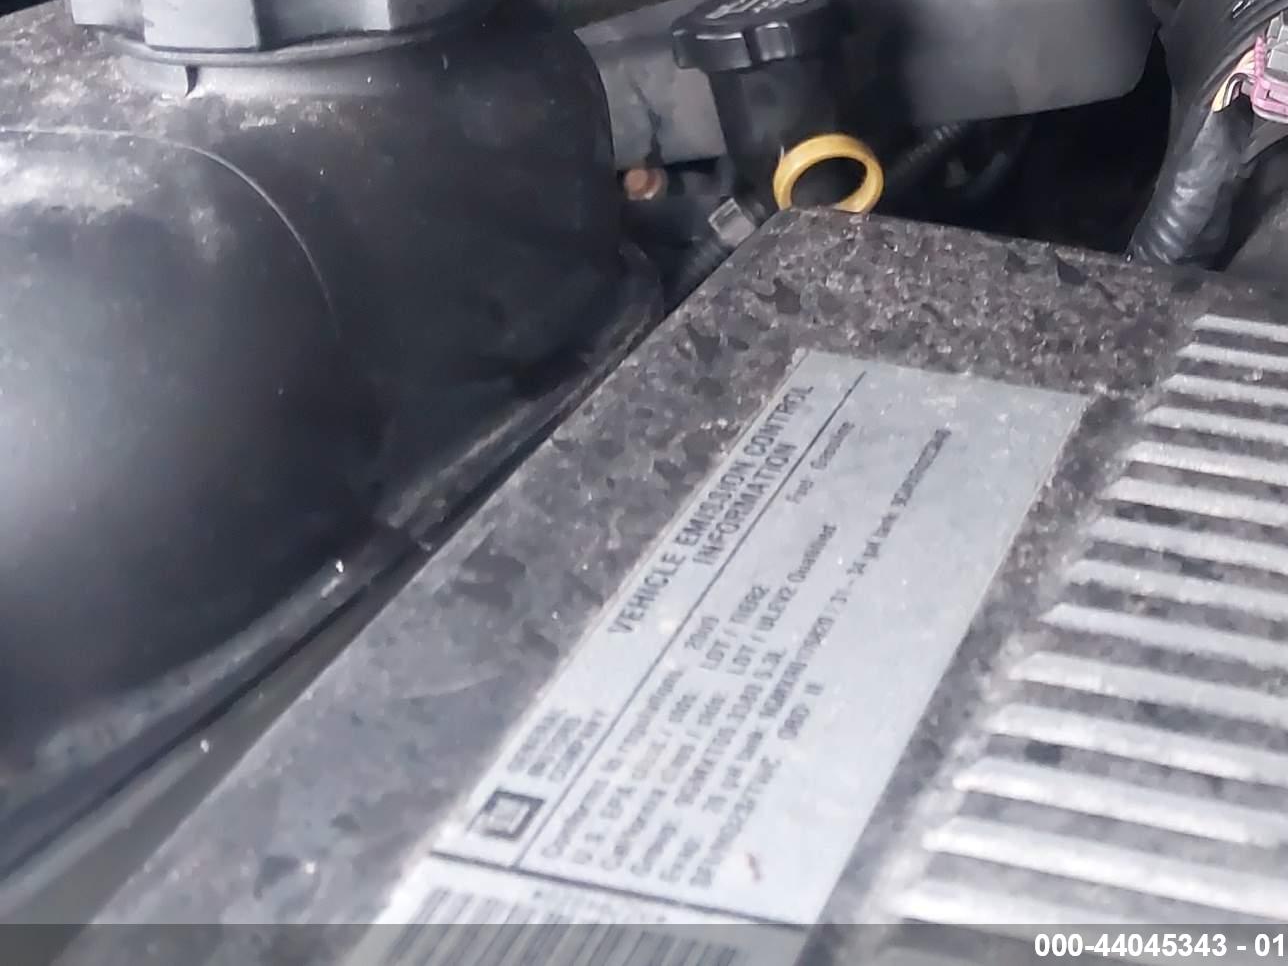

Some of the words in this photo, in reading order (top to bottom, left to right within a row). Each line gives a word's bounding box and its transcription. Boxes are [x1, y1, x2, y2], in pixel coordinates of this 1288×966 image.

[607, 551, 686, 634] VEHICLE
[672, 460, 755, 547] EMISSION
[740, 382, 814, 457] CONTROL
[692, 441, 799, 565] INFORMATION
